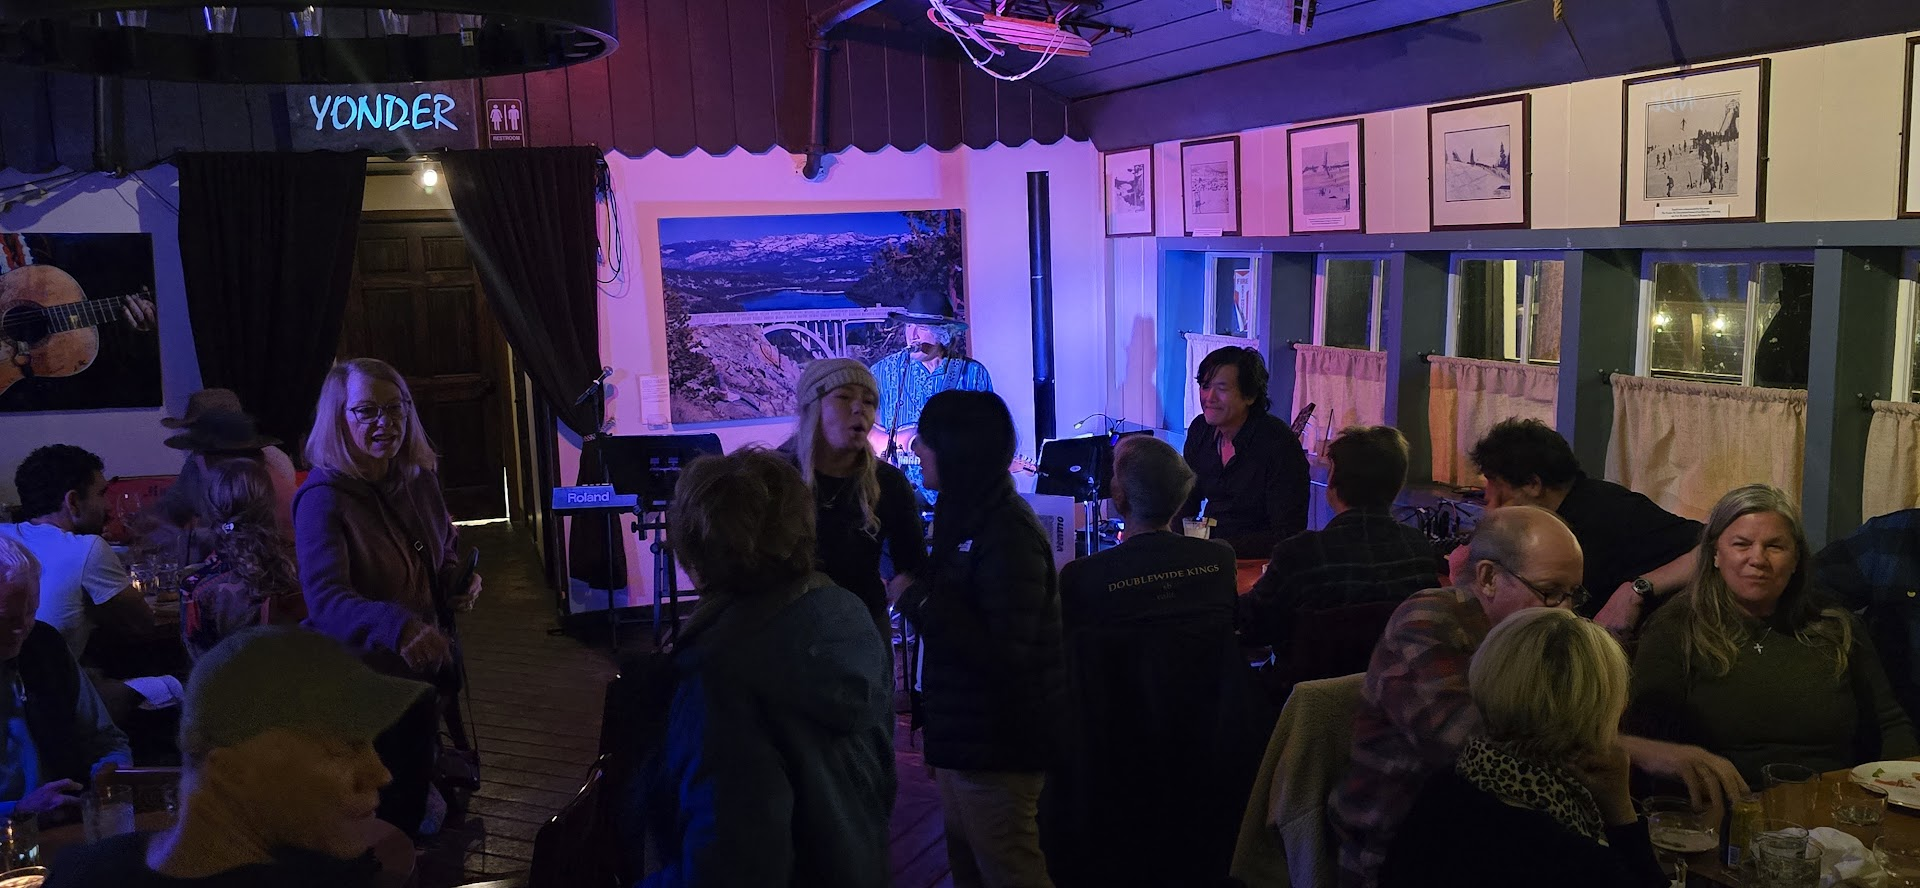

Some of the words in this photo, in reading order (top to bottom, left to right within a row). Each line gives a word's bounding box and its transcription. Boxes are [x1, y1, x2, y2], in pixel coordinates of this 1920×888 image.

[309, 93, 459, 131] YONDER
[567, 491, 610, 503] Roland
[1108, 570, 1185, 592] DOUBLEWIDE
[1186, 564, 1220, 576] KINGS
